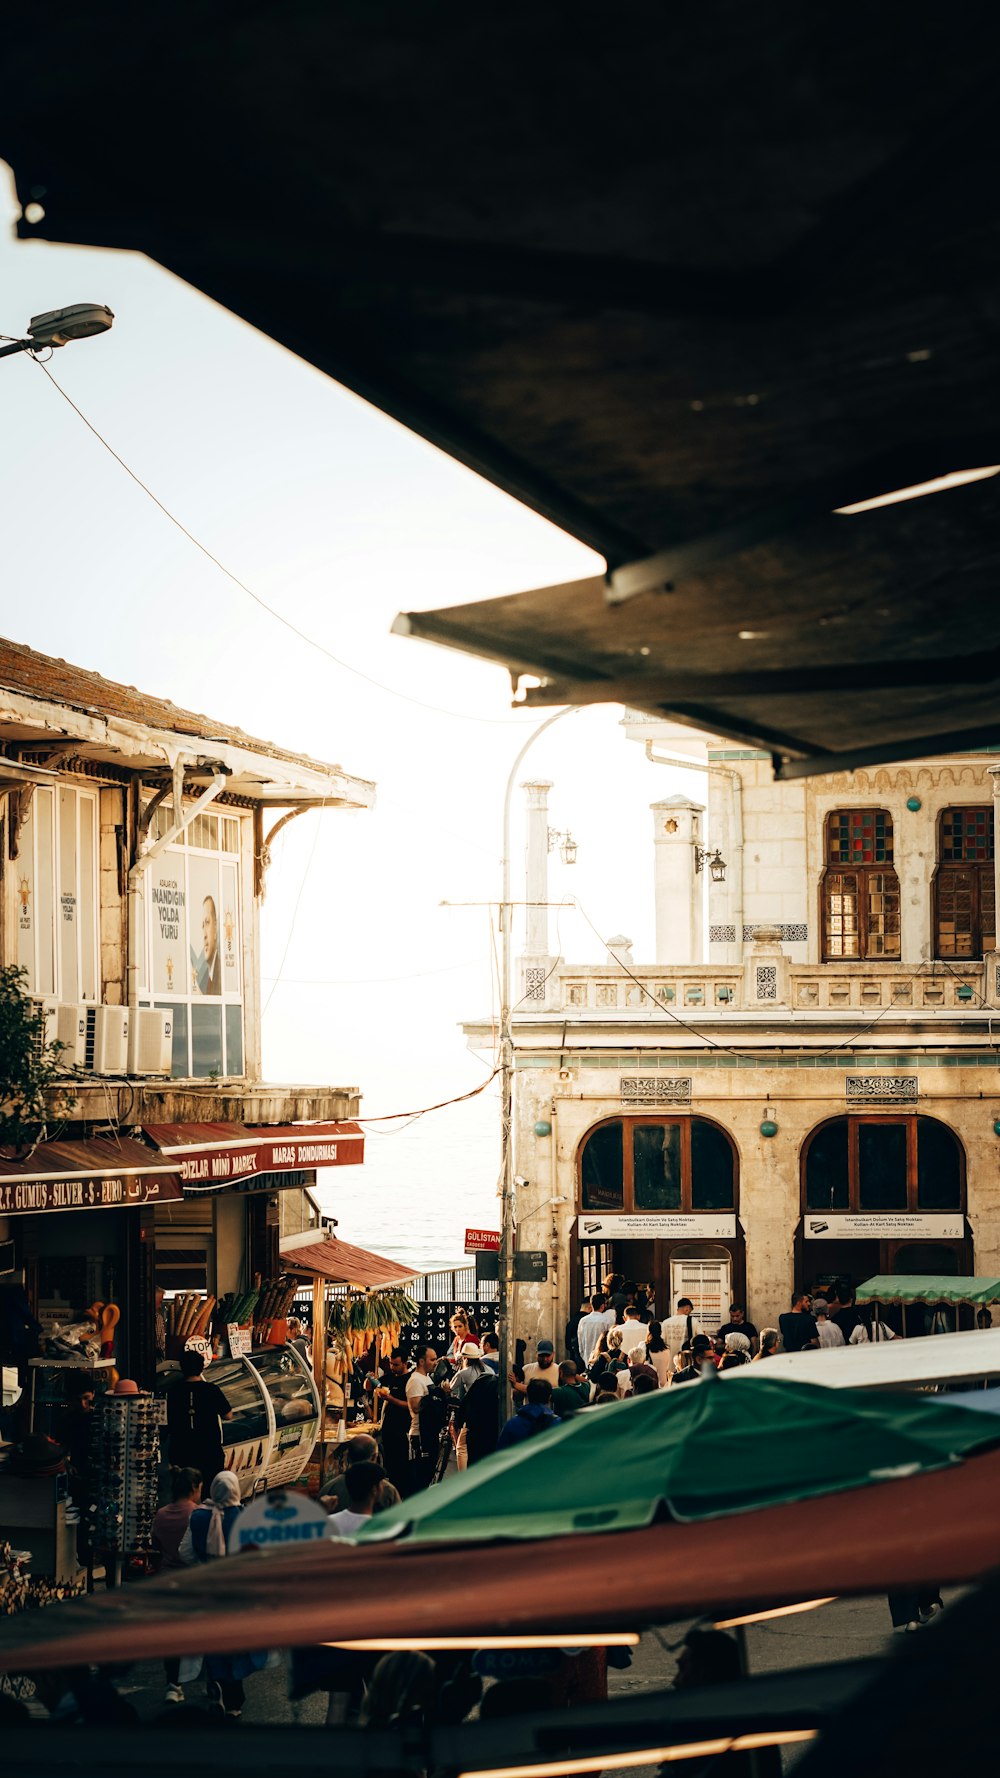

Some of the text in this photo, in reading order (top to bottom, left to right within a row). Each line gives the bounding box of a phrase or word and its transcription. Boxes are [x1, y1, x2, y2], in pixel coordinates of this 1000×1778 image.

[158, 906, 179, 922] YOLDA
[160, 924, 178, 940] YÜRÜ
[212, 1153, 230, 1177] MİNİ
[272, 1144, 337, 1167] MARAŞ DONDURMASI
[15, 1182, 47, 1209] GÜMÜŞ
[53, 1180, 83, 1206] SILVER
[101, 1180, 122, 1203] EURO
[467, 1232, 500, 1243] GÜLİSTAN
[193, 1342, 210, 1352] TOP
[239, 1521, 327, 1544] KORNET
